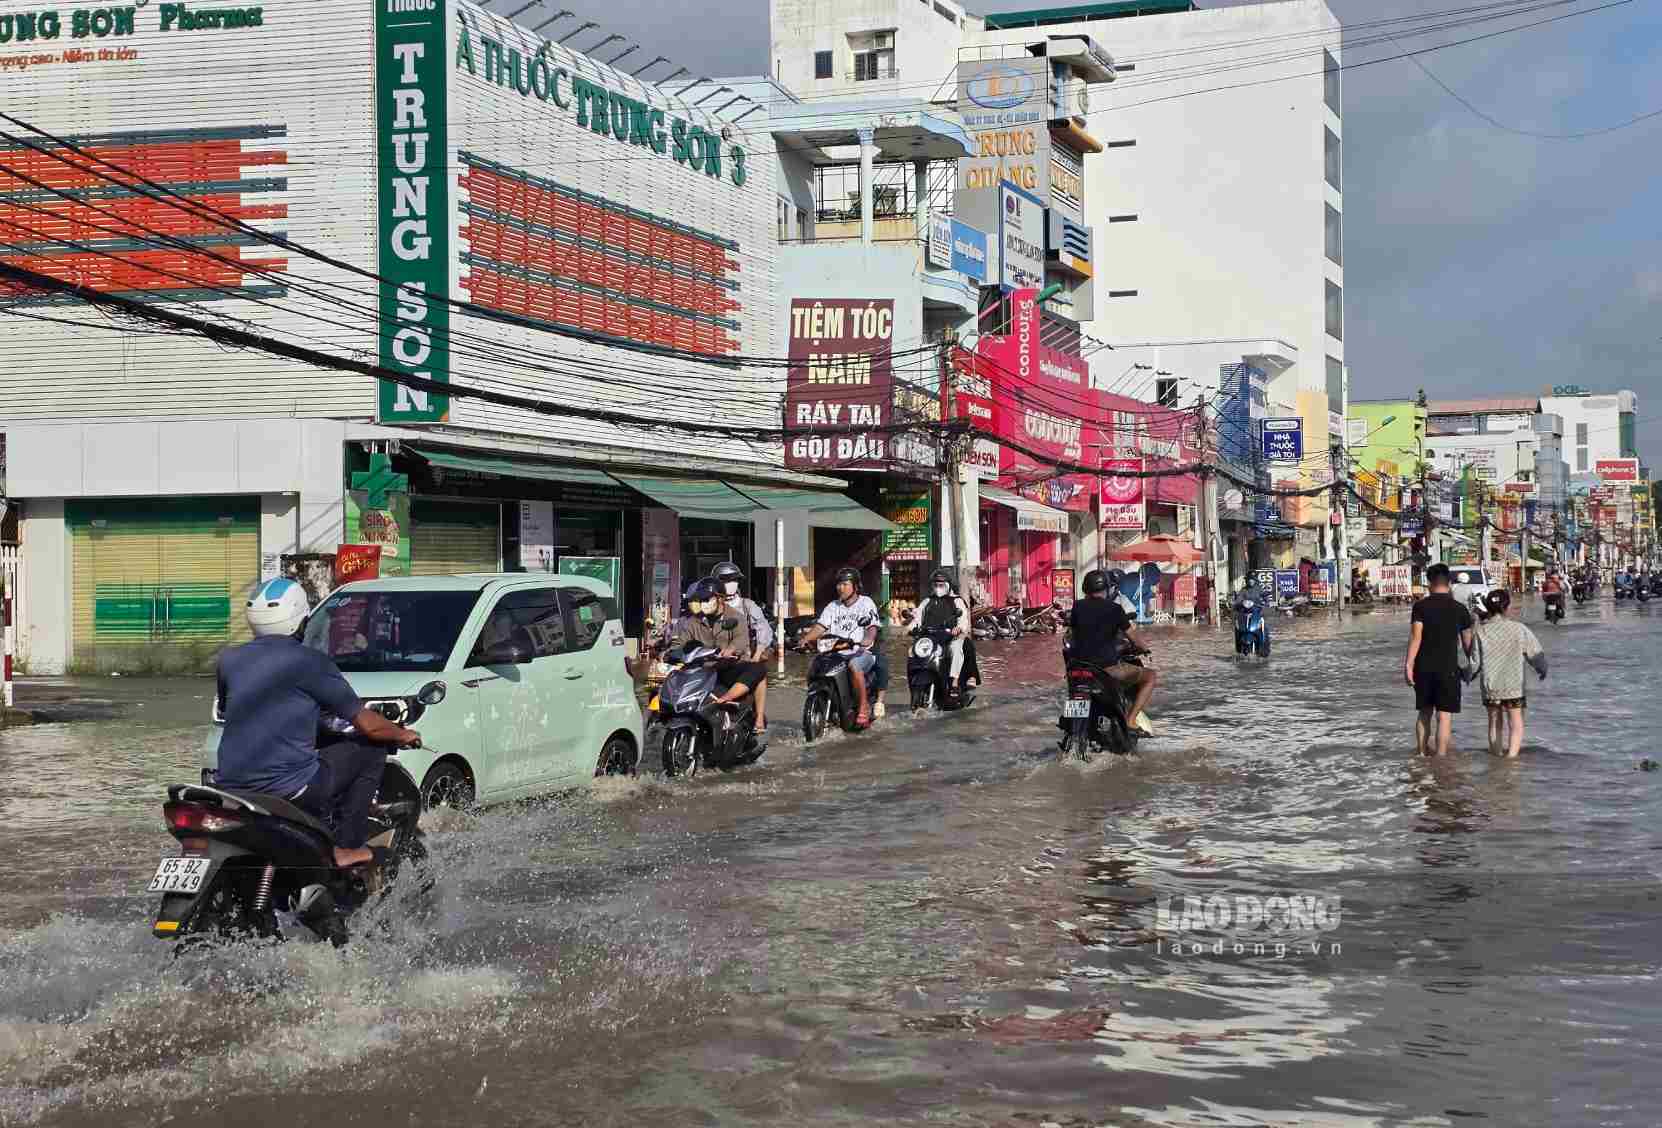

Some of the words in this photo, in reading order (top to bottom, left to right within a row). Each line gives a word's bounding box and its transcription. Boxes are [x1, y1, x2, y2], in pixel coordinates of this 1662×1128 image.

[160, 3, 263, 31] Pharma
[480, 40, 571, 111] THUỐC
[572, 76, 668, 155] TRUNG
[731, 144, 748, 186] 3
[392, 42, 432, 261] TRUNG
[792, 301, 844, 346] TIỆM
[851, 301, 892, 340] TÓC
[808, 353, 871, 385] NAM
[797, 400, 842, 424] RÁY
[849, 404, 881, 425] TAI
[792, 434, 831, 463] GỘI
[838, 432, 884, 460] ĐẦU
